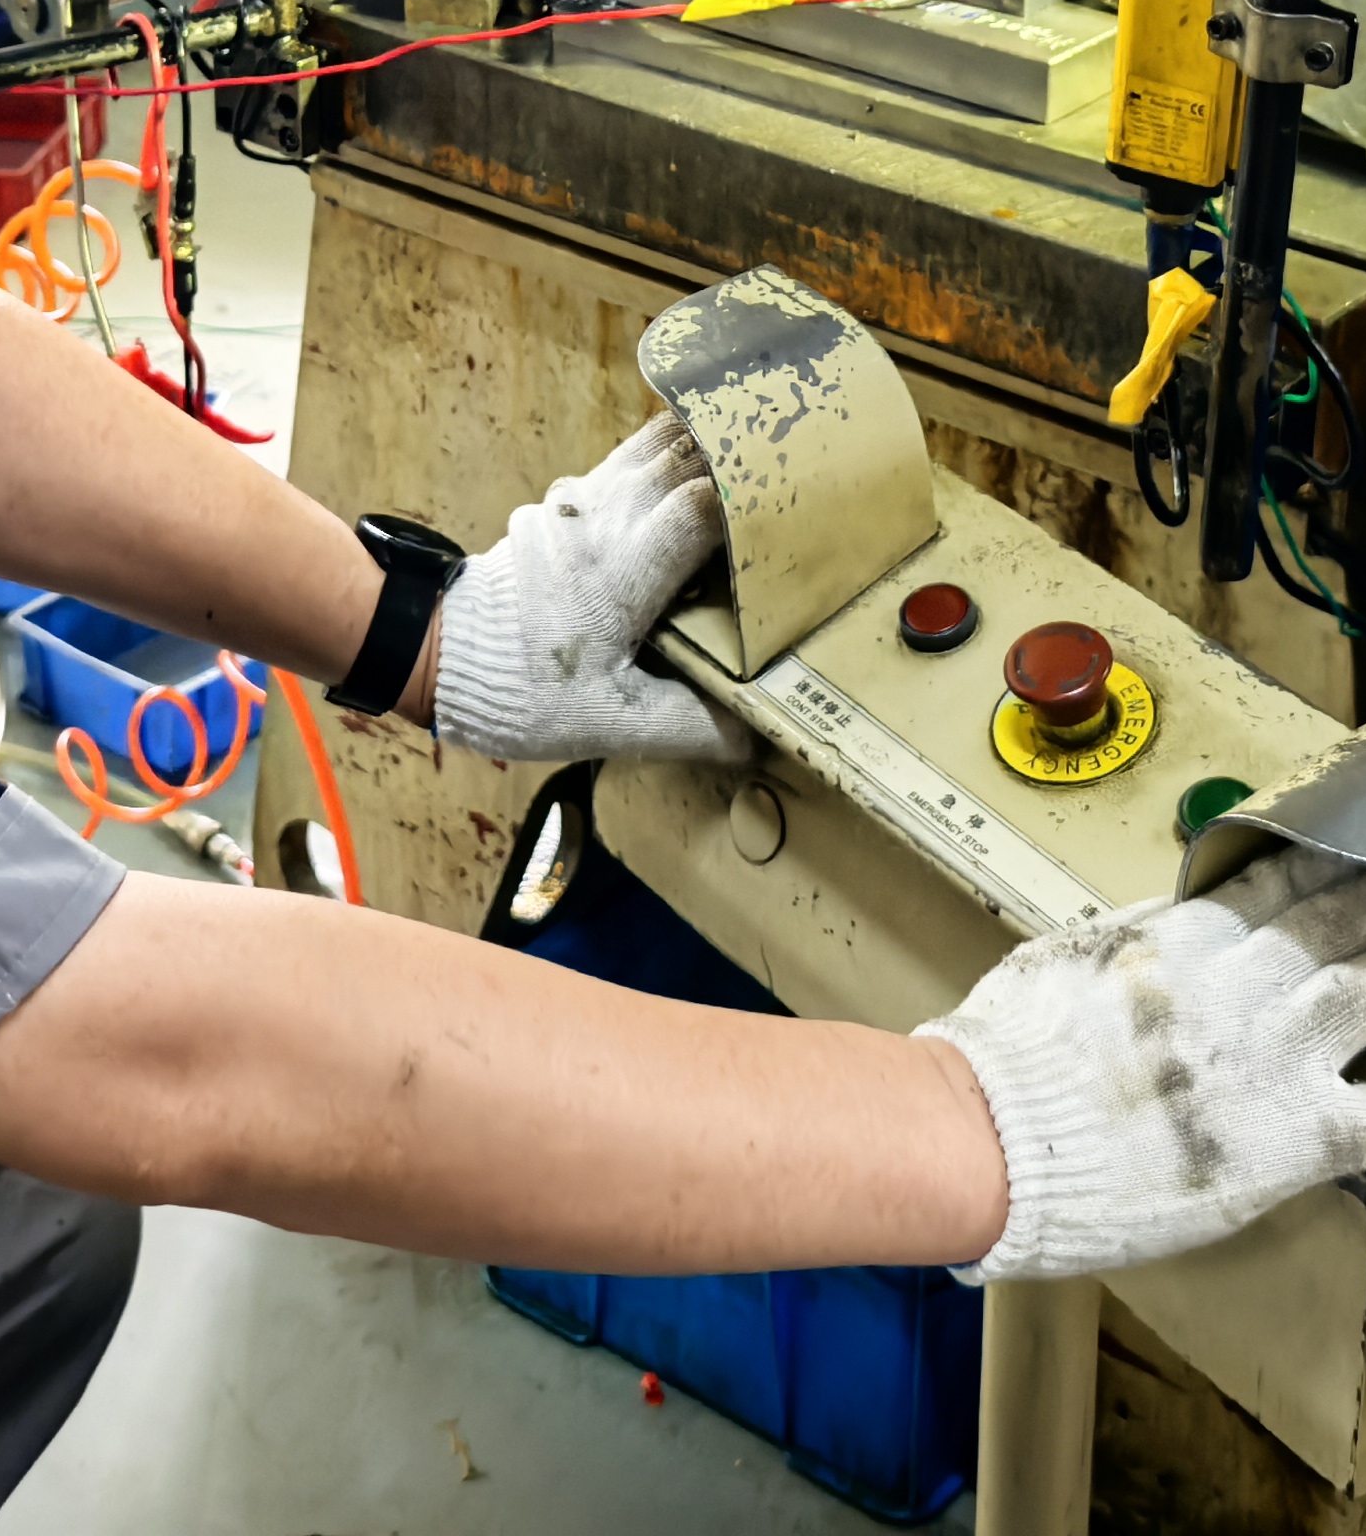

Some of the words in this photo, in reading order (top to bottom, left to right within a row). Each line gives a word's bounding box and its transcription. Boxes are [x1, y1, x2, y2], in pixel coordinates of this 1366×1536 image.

[785, 694, 812, 715] CONT
[809, 713, 834, 732] STOP
[792, 678, 851, 728] 连续停止
[1023, 683, 1147, 775] EMERGENCY
[907, 791, 963, 837] EMERGENCY
[961, 833, 989, 856] STOP
